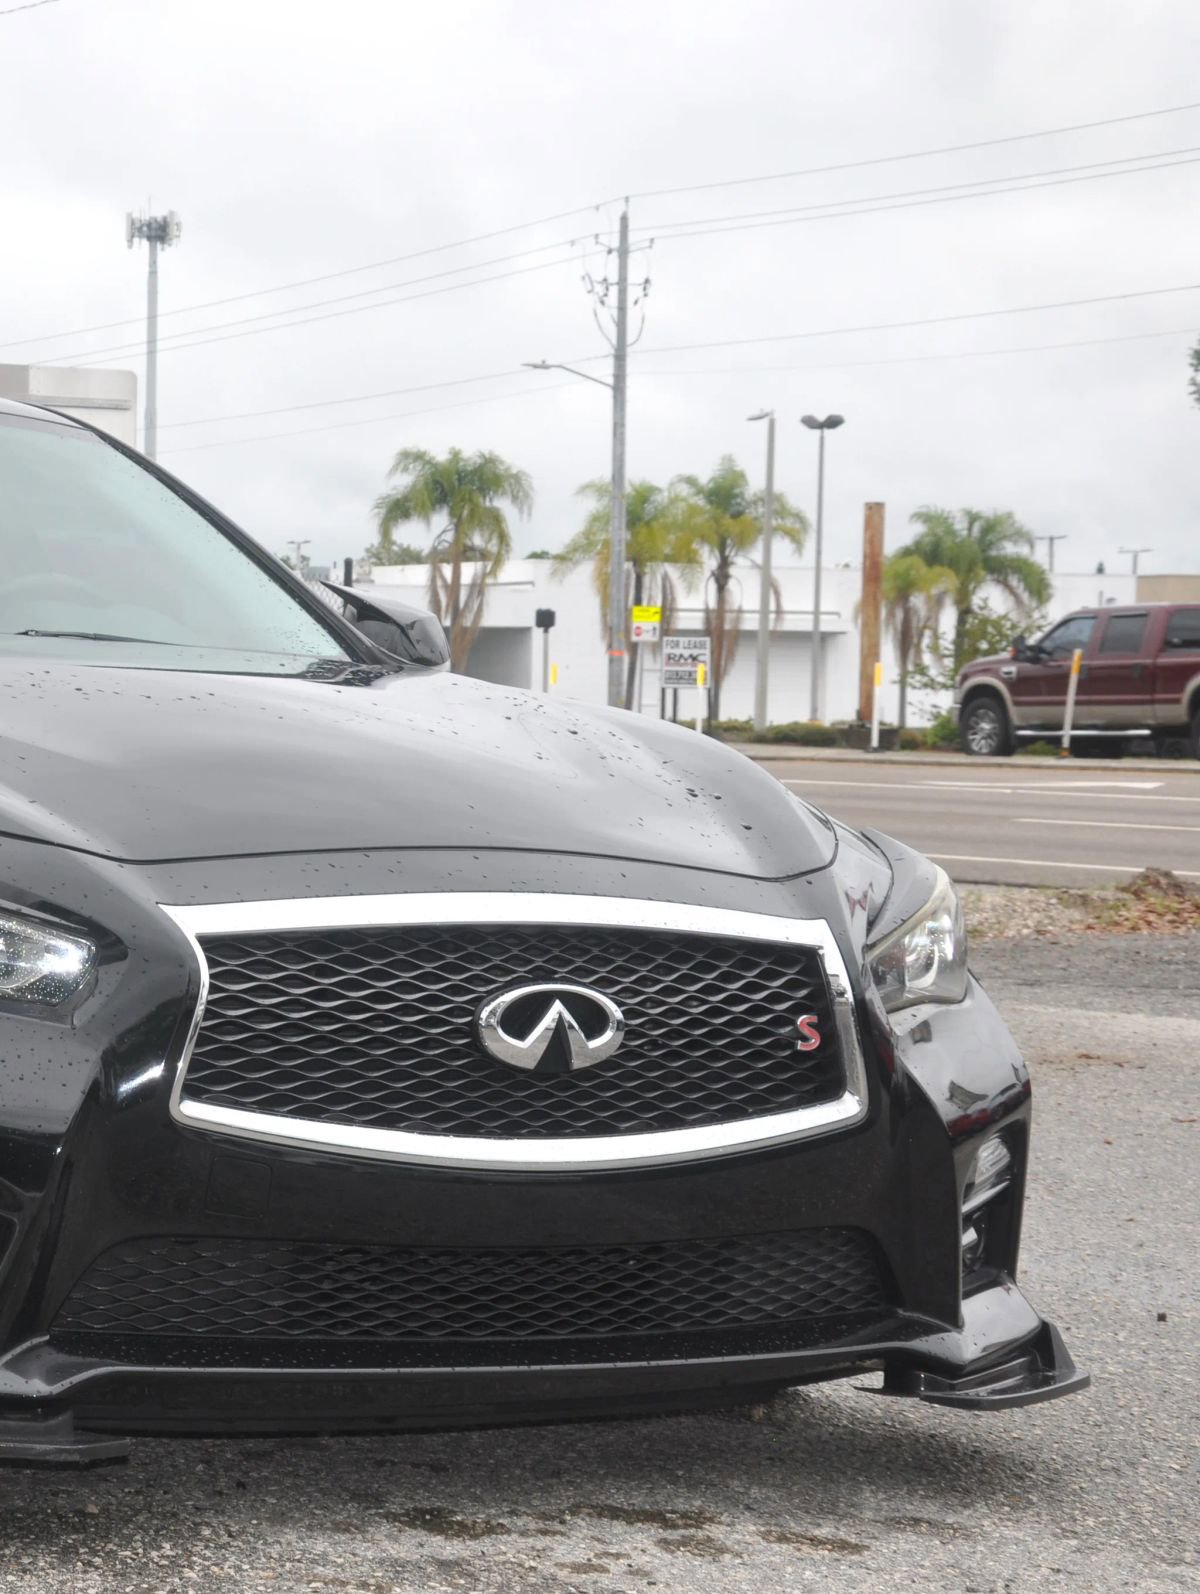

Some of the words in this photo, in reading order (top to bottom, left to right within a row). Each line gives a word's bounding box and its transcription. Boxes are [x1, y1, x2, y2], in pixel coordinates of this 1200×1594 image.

[665, 639, 681, 650] FOR
[682, 639, 707, 650] LEASE
[797, 1014, 821, 1051] S
